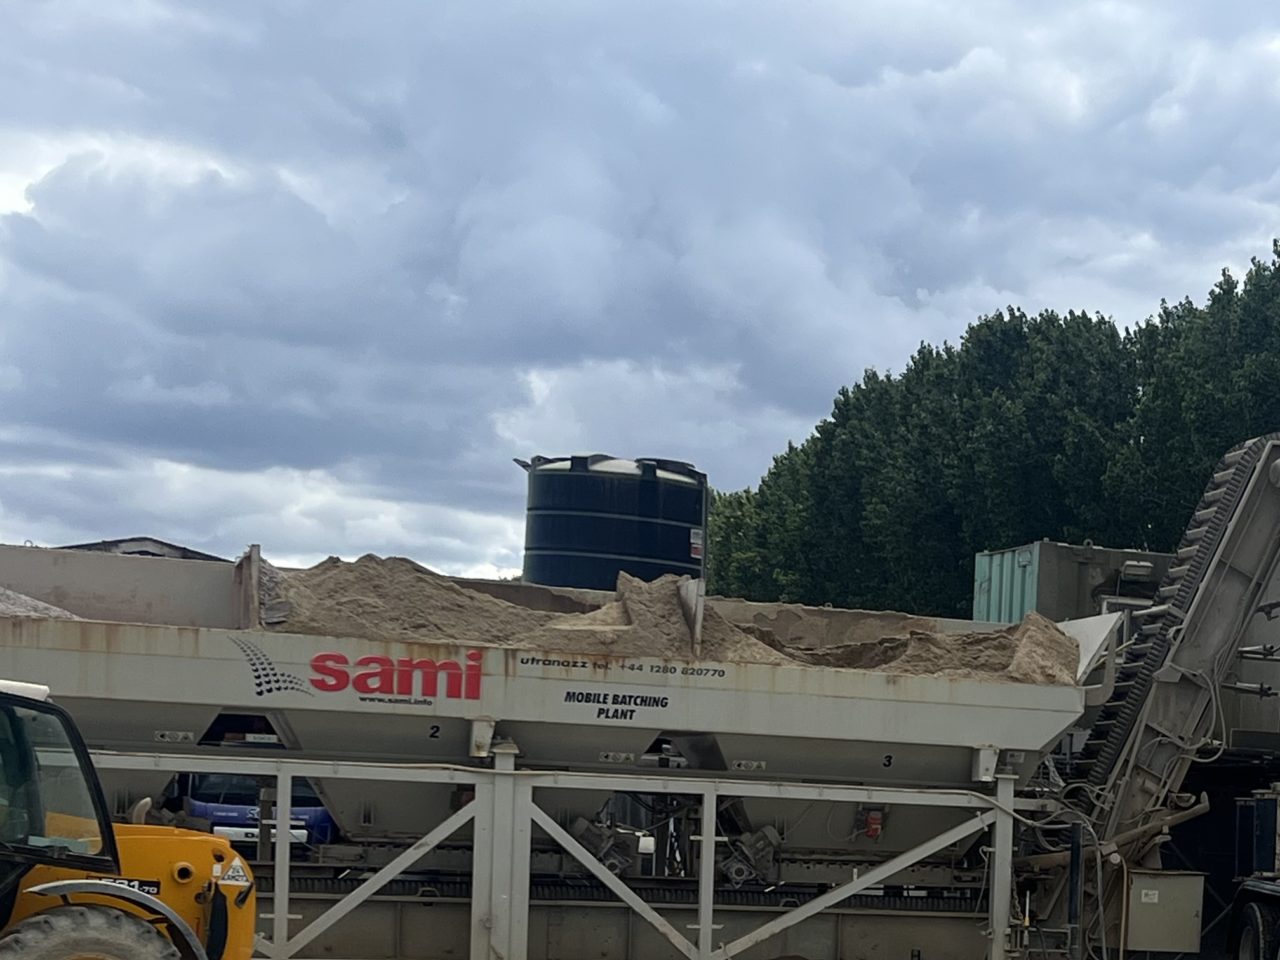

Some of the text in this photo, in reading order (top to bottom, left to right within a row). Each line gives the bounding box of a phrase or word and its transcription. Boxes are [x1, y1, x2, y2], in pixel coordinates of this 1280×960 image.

[520, 655, 588, 669] utranazz
[618, 664, 643, 672] +44
[650, 665, 677, 675] 1280
[681, 667, 725, 678] 820770
[308, 650, 482, 700] sami
[564, 691, 669, 708] MOBILE BATCHING
[596, 707, 636, 720] PLANT
[429, 725, 440, 738] 2
[883, 755, 893, 768] 3
